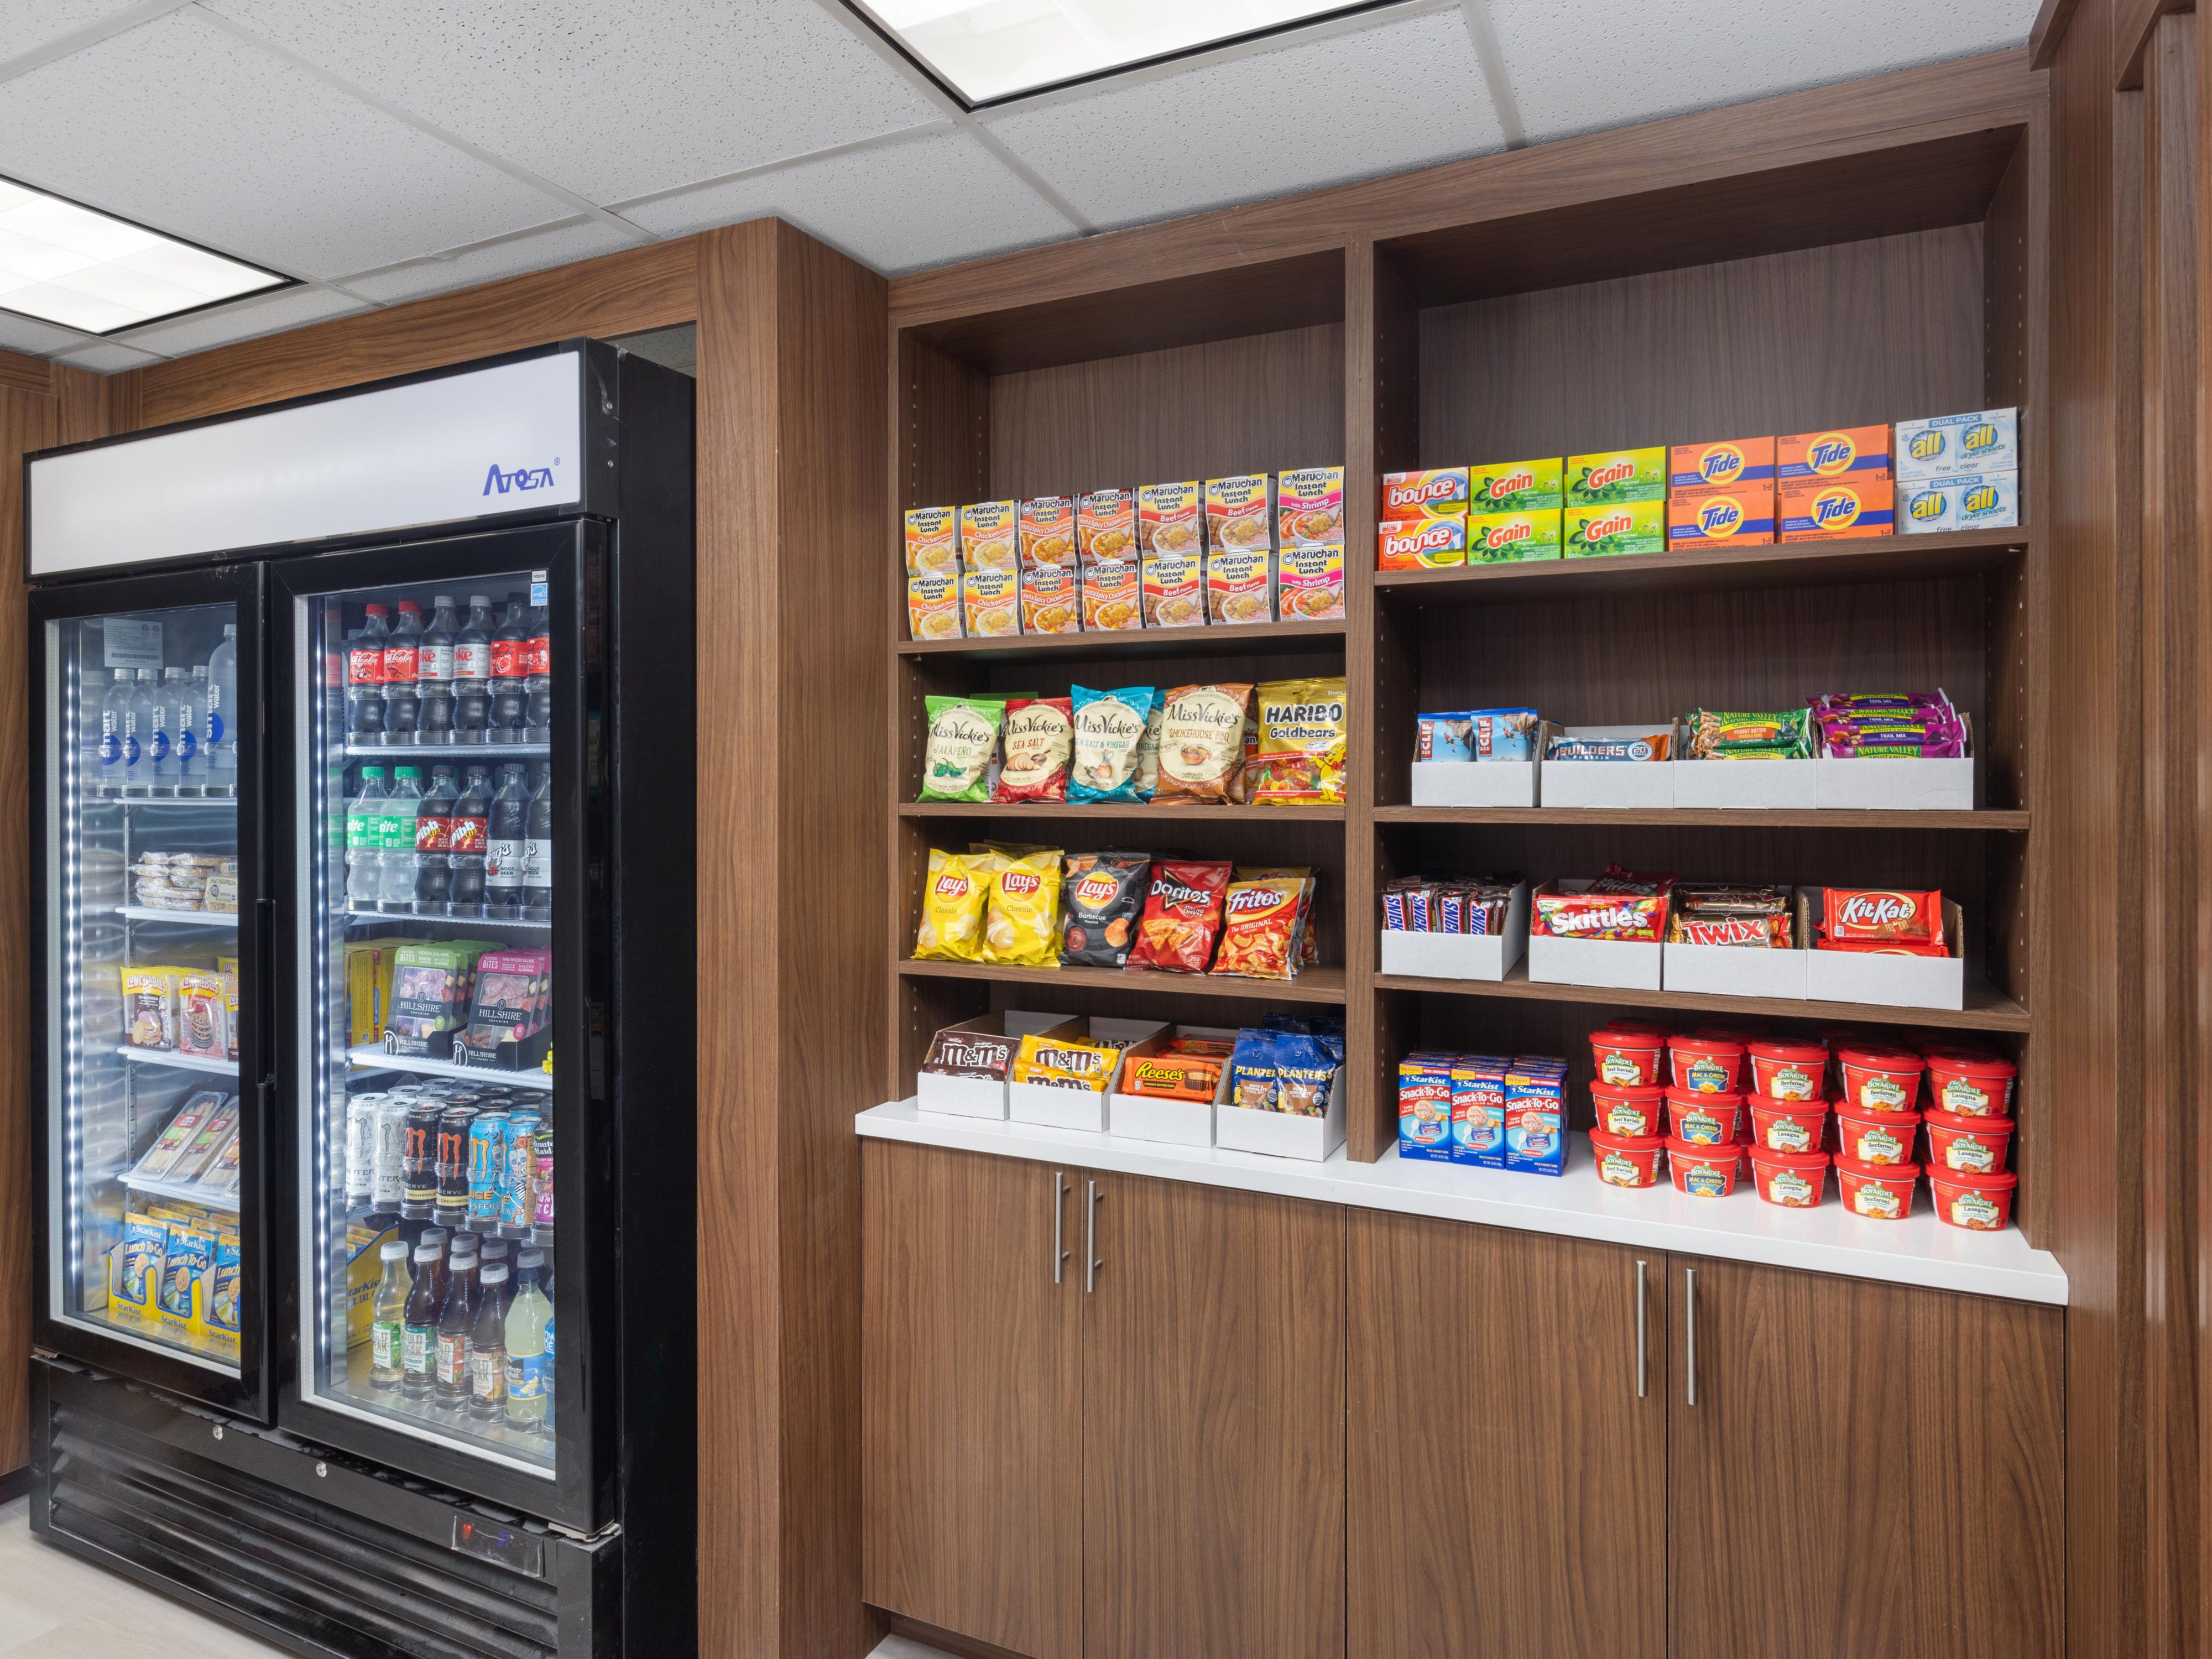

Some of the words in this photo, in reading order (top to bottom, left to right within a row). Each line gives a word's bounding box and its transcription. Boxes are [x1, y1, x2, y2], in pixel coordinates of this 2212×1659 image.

[1911, 431, 1942, 458] all
[1965, 424, 1994, 450] all
[1812, 442, 1851, 469] Tide
[1960, 450, 1979, 459] dryer
[1981, 444, 2005, 454] sheets
[1703, 452, 1740, 479] Tide
[483, 464, 554, 496] ATOSA
[1292, 471, 1339, 482] Maruchan
[1589, 463, 1634, 488] Gain
[1151, 486, 1193, 496] Maruchan
[1298, 488, 1324, 497] Lunch
[1390, 479, 1455, 507] bounce
[1490, 474, 1533, 498] Gain
[1030, 500, 1071, 509] Maruchan
[1154, 495, 1183, 504] Instant
[1301, 498, 1329, 509] Shrimp
[1912, 492, 1943, 519] all
[1966, 487, 1995, 512] all
[915, 511, 950, 520] Maruchan
[1817, 497, 1855, 524] Tide
[1962, 512, 1980, 520] dryer
[1983, 506, 2006, 515] sheets
[1701, 506, 1739, 532] Tide
[1586, 515, 1632, 541] Gain
[1386, 529, 1451, 557] bounce
[1488, 524, 1531, 548] Gain
[975, 574, 1013, 583] Maruchan
[1167, 703, 1196, 721] Miss
[1196, 703, 1238, 728] Vickie's
[1266, 703, 1343, 724] HARIBO
[953, 721, 990, 745] Vickie's
[1027, 714, 1064, 737] Vickie's
[1101, 713, 1139, 738] Vickie's
[1271, 727, 1335, 739] Goldbears
[1027, 738, 1045, 747] SALT
[1169, 729, 1213, 740] SMOKEHOUSE
[1215, 732, 1230, 744] BBQ
[1422, 723, 1432, 750] CLIF
[934, 744, 972, 757] JALAPEÑO
[1560, 745, 1625, 757] BUILDERS
[1858, 747, 1890, 757] NATURE
[1891, 747, 1920, 758] VALLEY
[451, 821, 476, 846] Pibb
[936, 876, 967, 896] Lay's
[1005, 872, 1039, 893] Lay's
[1079, 880, 1117, 900] Lay's
[1151, 880, 1211, 904] Doritos
[1006, 905, 1032, 913] Classic
[1229, 889, 1282, 914] Fritos
[1078, 912, 1107, 921] Barbecue
[1551, 907, 1648, 935] Skittles
[1240, 919, 1272, 931] ORIGINAL
[127, 975, 166, 992] LUNCHABLES
[400, 1001, 441, 1013] HILLSHIRE
[479, 1009, 521, 1020] HILLSHIRE
[942, 1043, 1008, 1067] m&m's
[1035, 1049, 1102, 1071] m&m's
[1605, 1058, 1633, 1067] BOYARDEE
[1135, 1061, 1185, 1081] Reese's
[1278, 1068, 1327, 1081] PLANTERS
[1694, 1063, 1724, 1072] BOYARDEE
[1411, 1076, 1446, 1084] StarKist
[1463, 1081, 1499, 1090] StarKist
[1867, 1081, 1901, 1091] BOYARDEE
[1517, 1086, 1556, 1096] StarKist
[1958, 1198, 1994, 1208] BOYARDEE
[136, 1225, 162, 1240] StarKist
[125, 1243, 145, 1255] Lunch
[180, 1238, 206, 1251] StarKist
[117, 1301, 141, 1316] StarKist
[161, 1315, 186, 1329] StarKist
